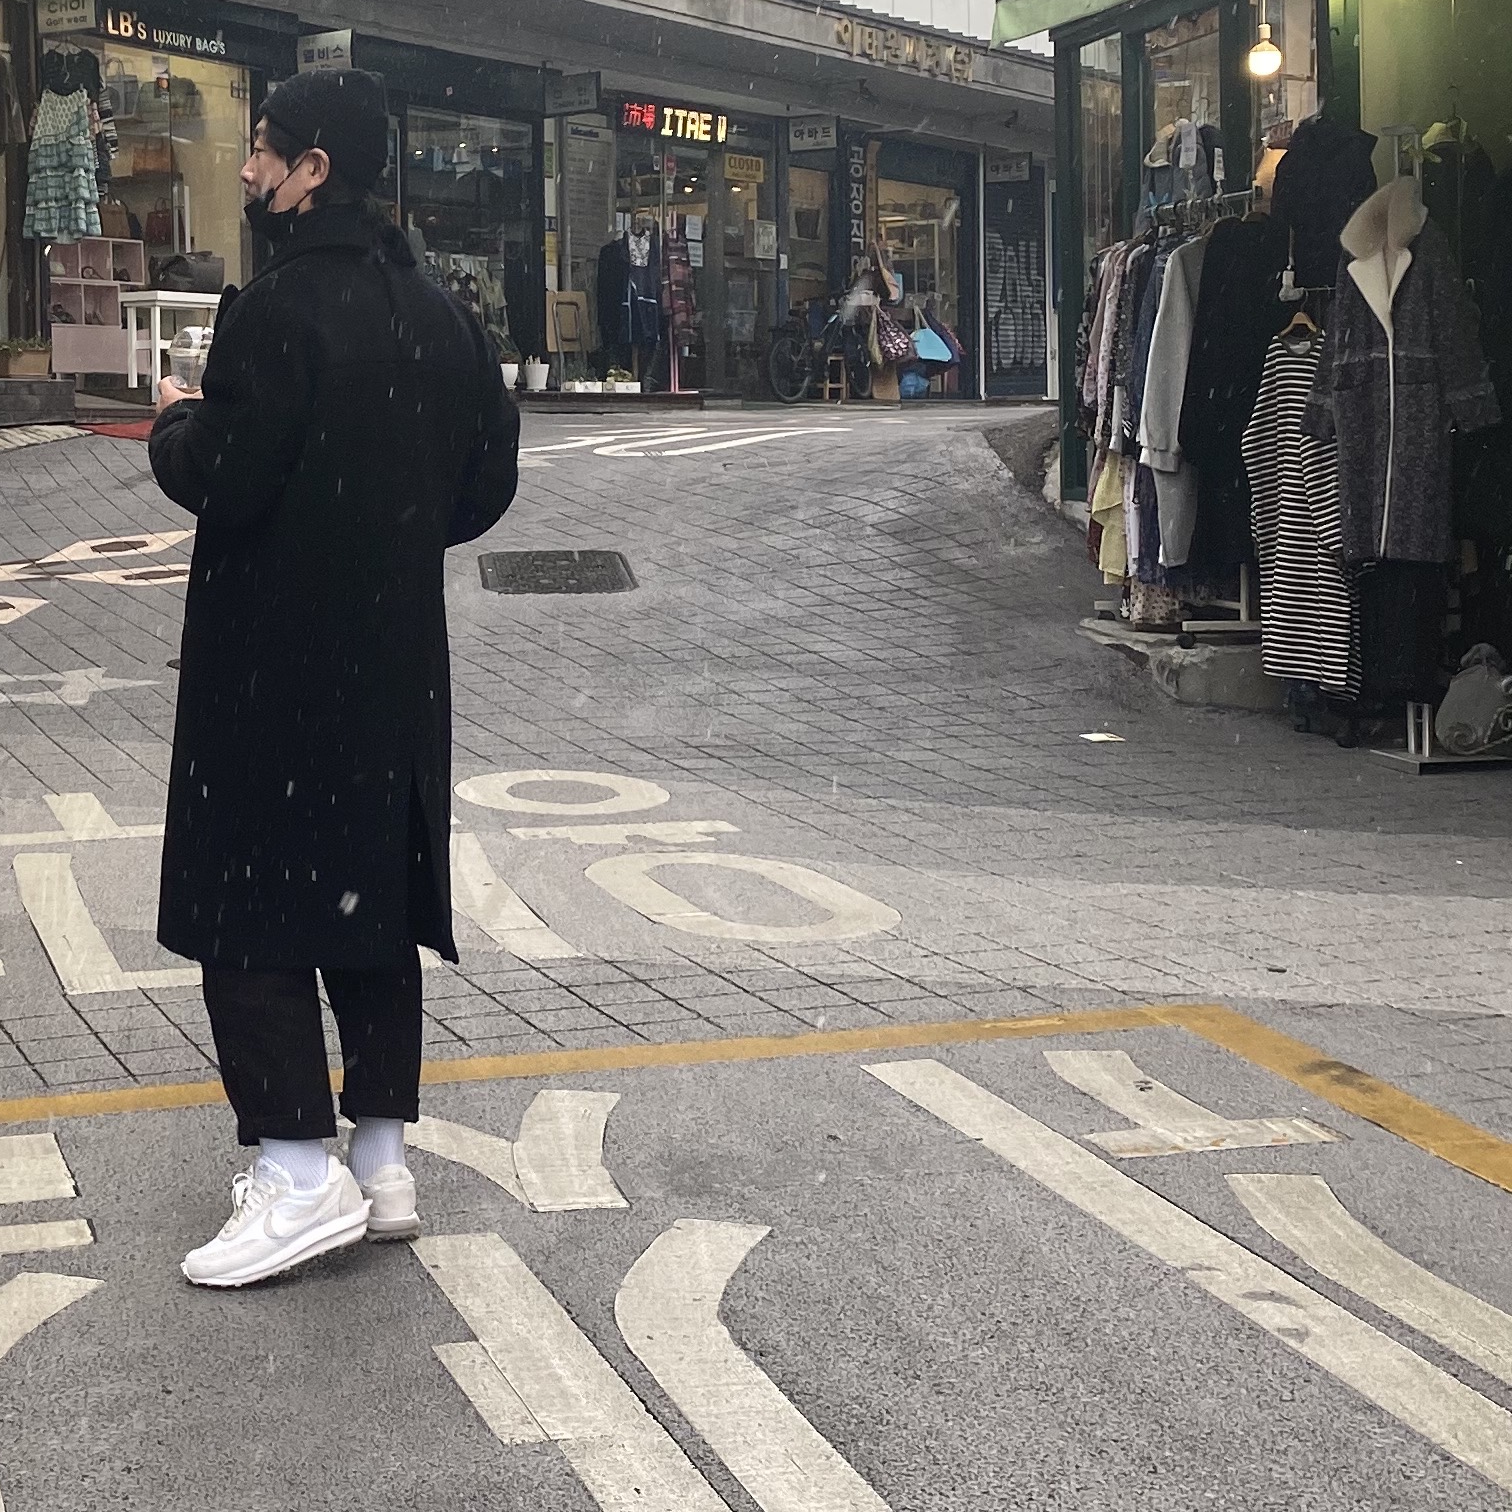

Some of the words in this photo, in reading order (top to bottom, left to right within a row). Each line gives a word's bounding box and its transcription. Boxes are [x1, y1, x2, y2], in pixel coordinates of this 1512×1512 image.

[152, 27, 193, 49] LUXURY
[195, 37, 226, 55] BAG'S
[728, 155, 761, 173] CLOSED
